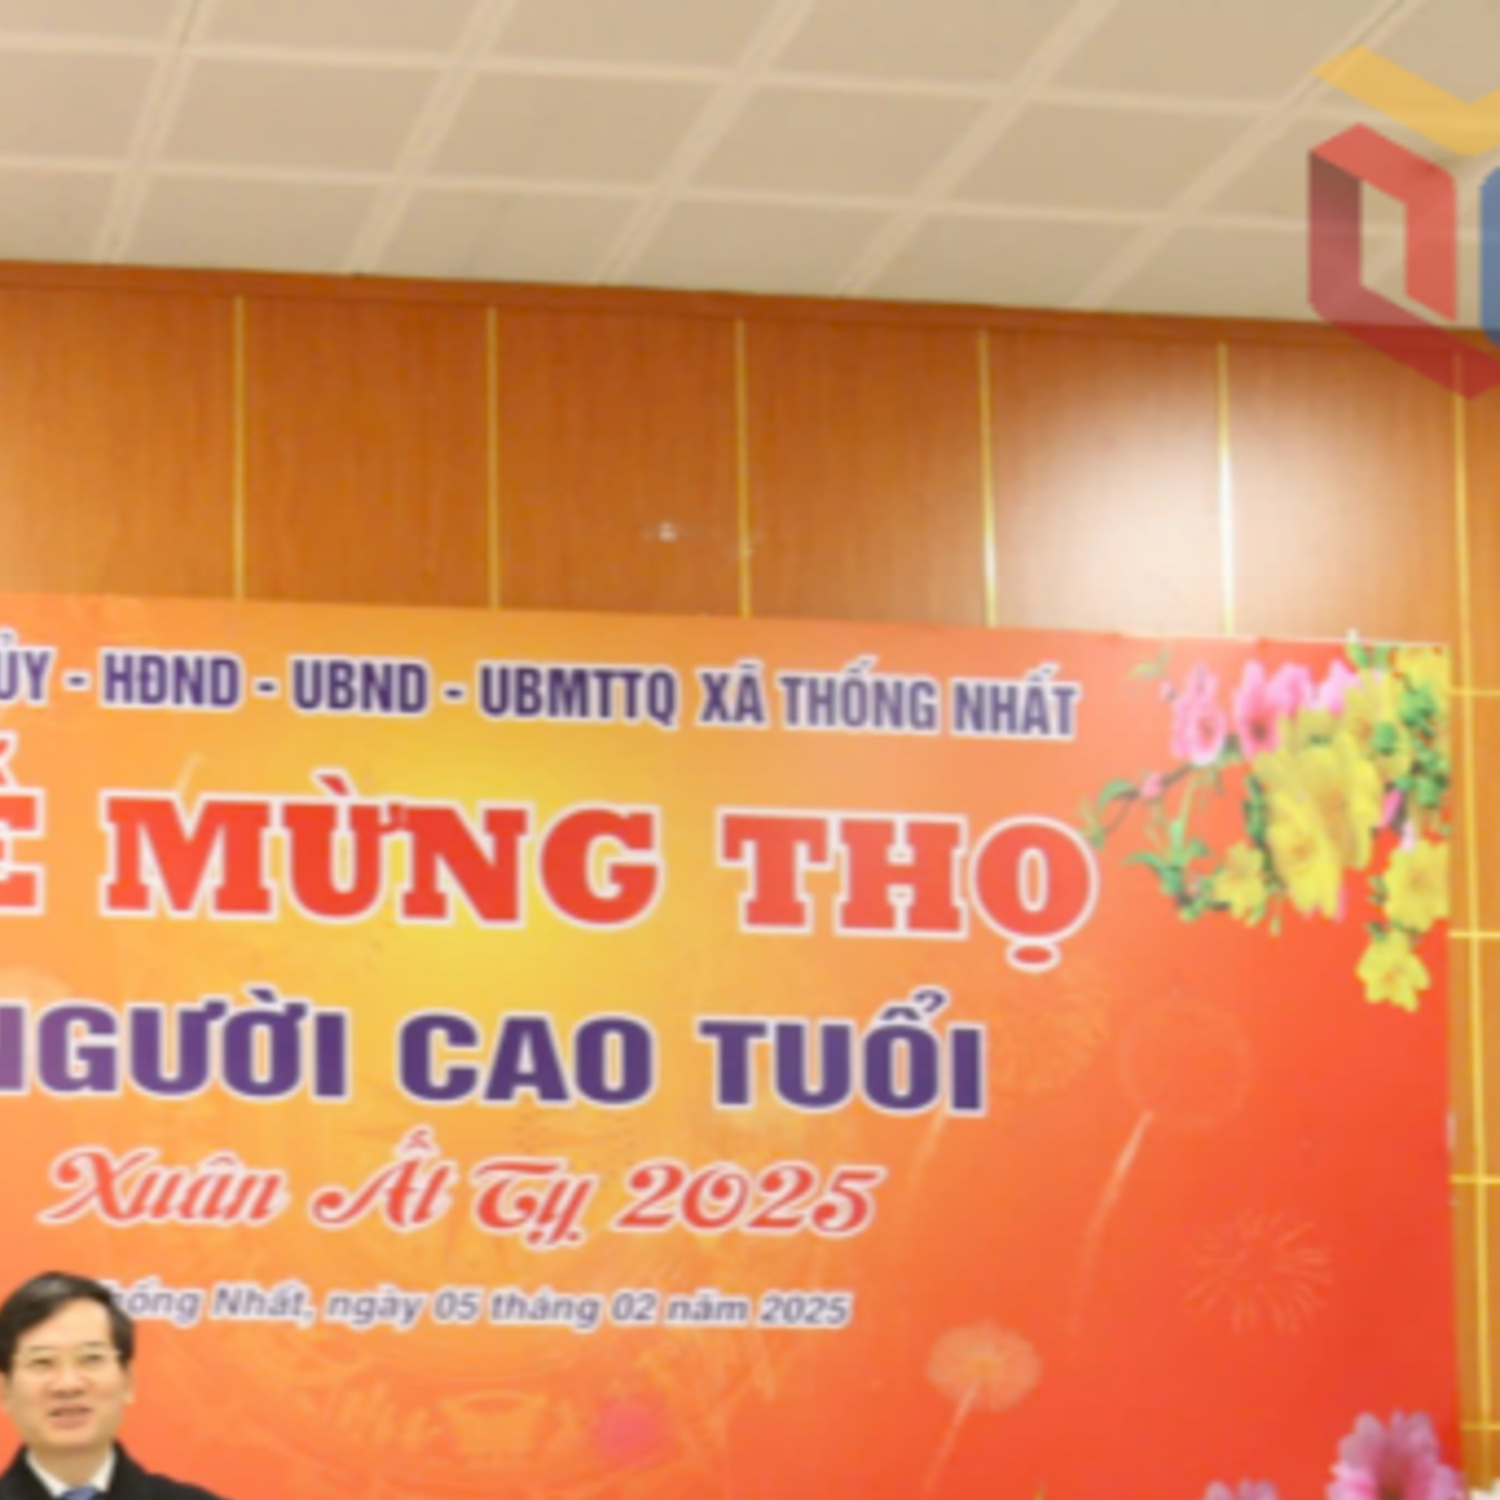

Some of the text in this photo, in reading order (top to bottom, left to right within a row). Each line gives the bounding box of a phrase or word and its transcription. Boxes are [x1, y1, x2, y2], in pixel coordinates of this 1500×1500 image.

[100, 649, 241, 709] HĐND
[291, 655, 430, 715] UBND
[479, 663, 679, 728] UBMTTQ
[698, 660, 765, 726] XÃ
[780, 656, 940, 734] THỐNG
[952, 662, 1078, 739] NHẤT
[100, 769, 660, 929] MỪNG
[717, 806, 1098, 972] THỌ
[398, 1010, 656, 1106] CAO
[695, 985, 986, 1116] TUỔI
[37, 1125, 886, 1251] Xuân Ất Tỵ 2025
[326, 1285, 423, 1326] ngày
[434, 1287, 481, 1321] 05
[490, 1286, 600, 1332] tháng
[611, 1292, 657, 1324] 02
[666, 1292, 749, 1324] năm
[759, 1293, 851, 1327] 2025
